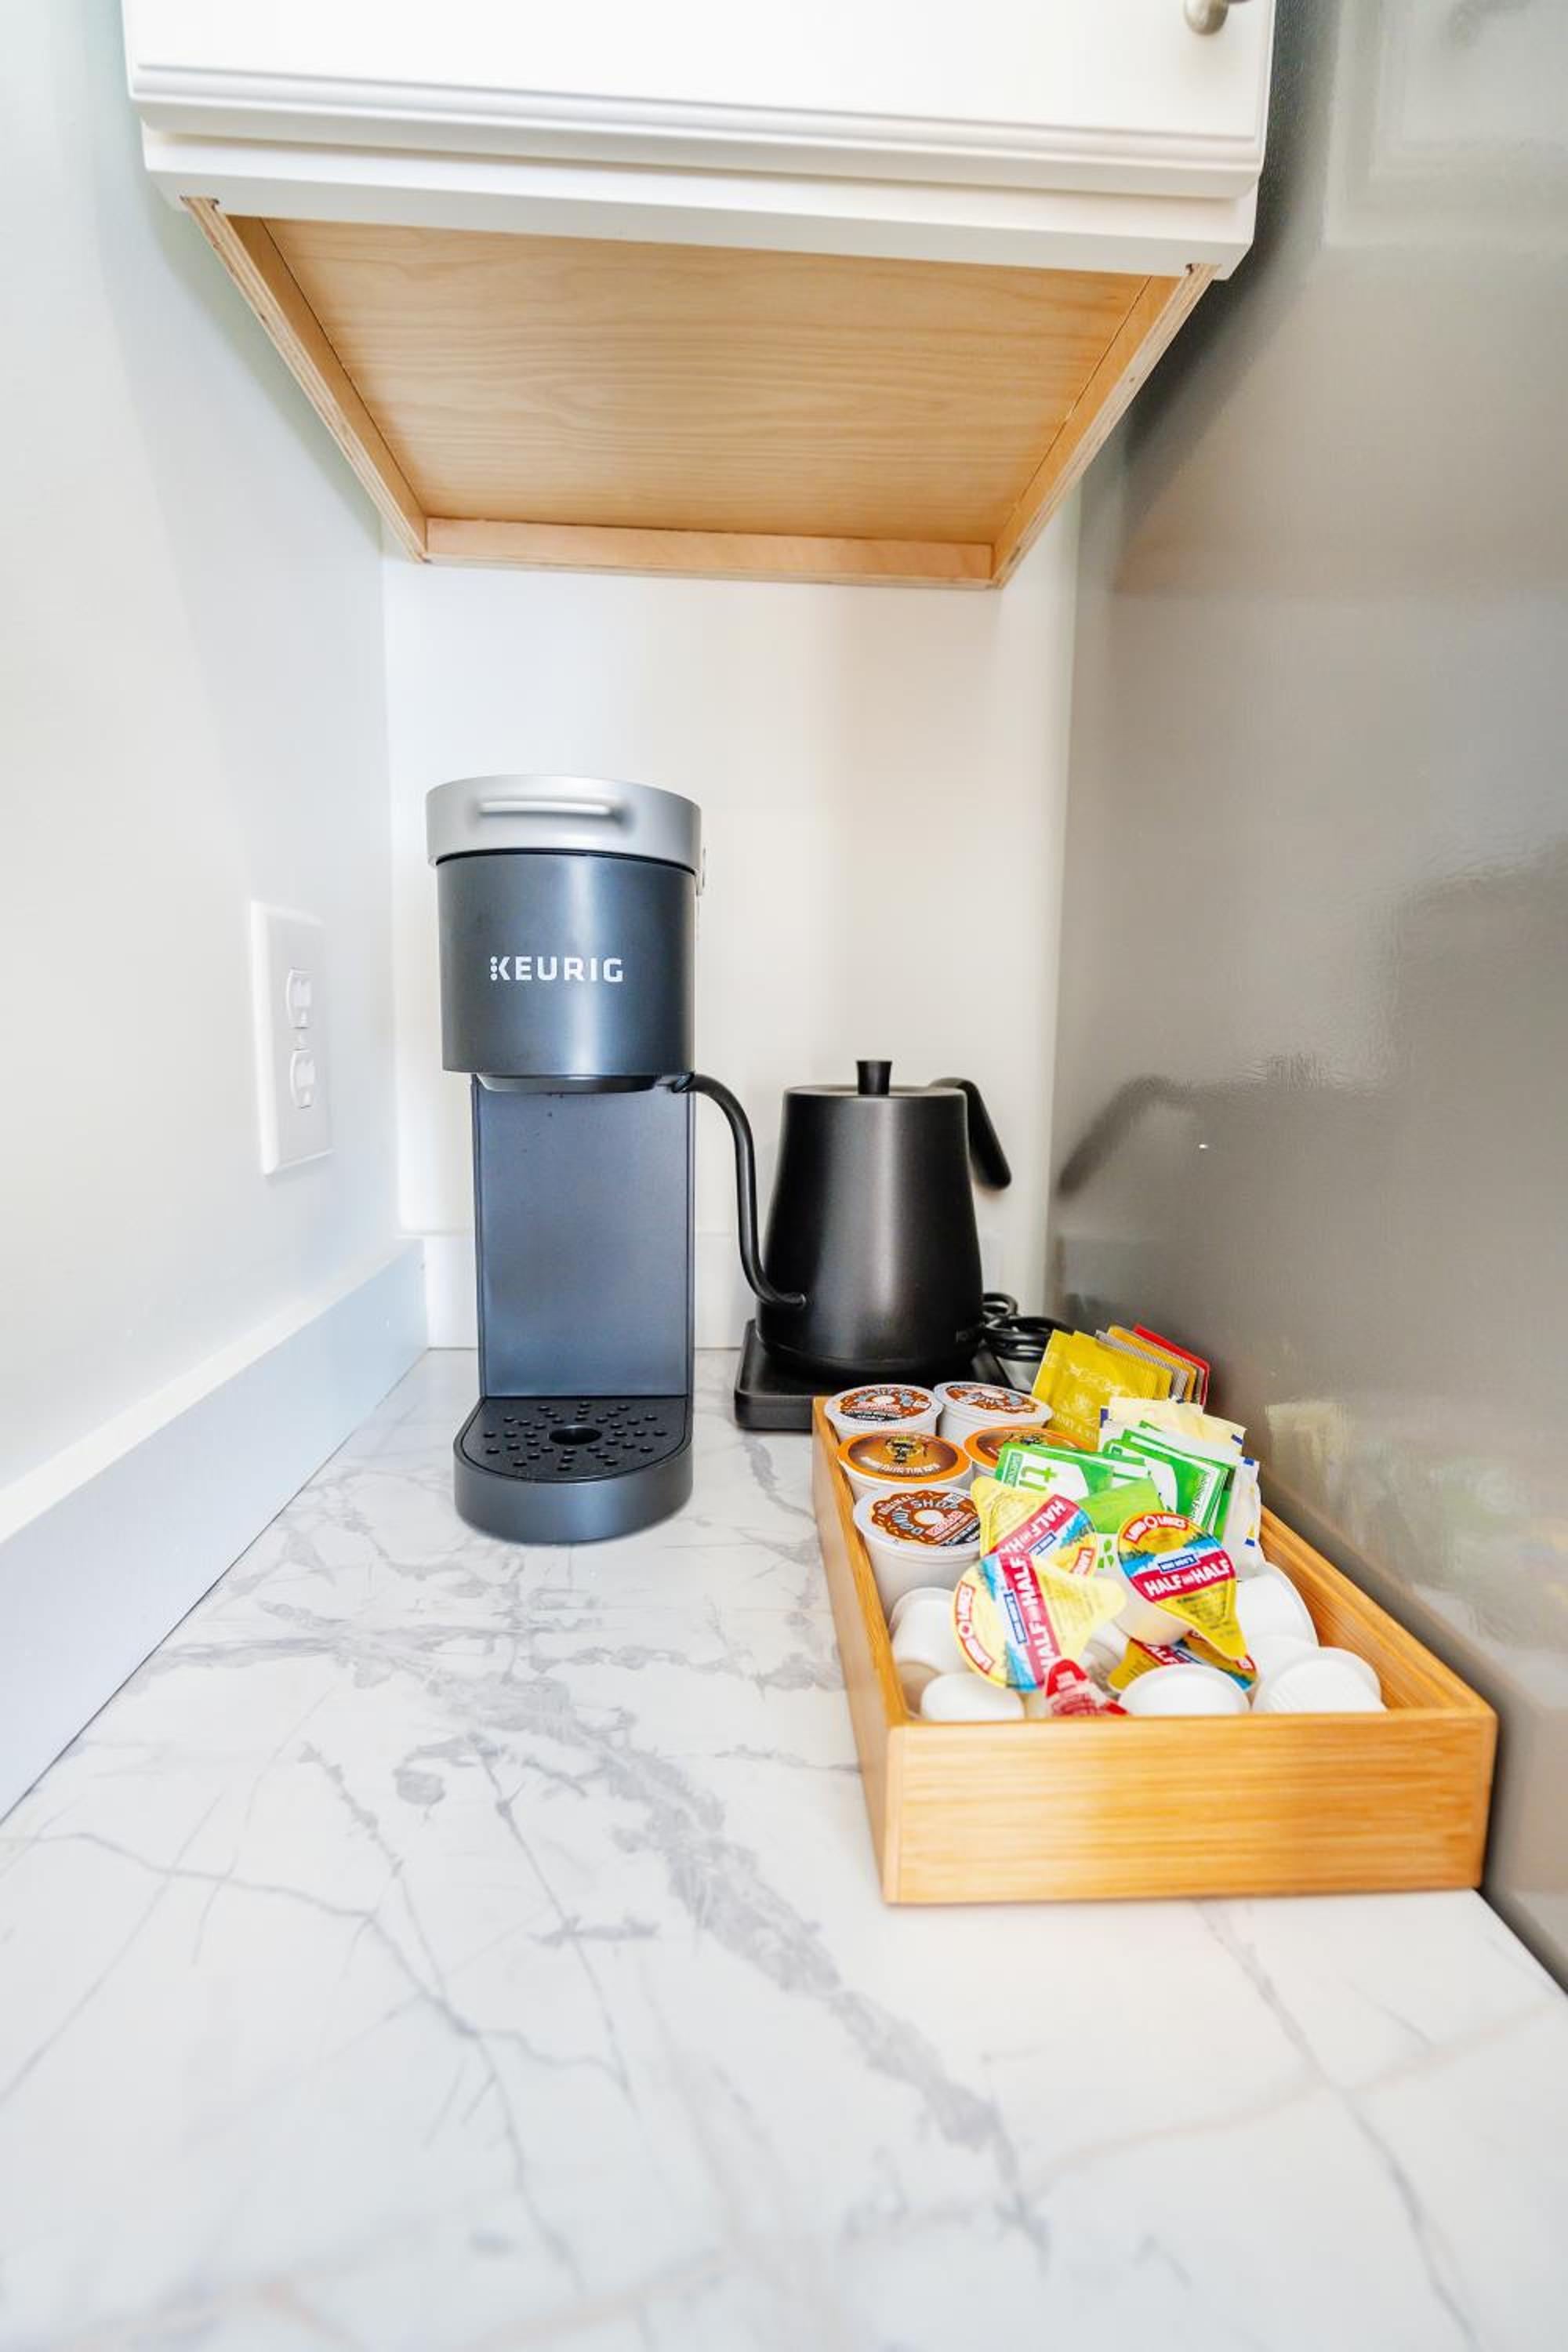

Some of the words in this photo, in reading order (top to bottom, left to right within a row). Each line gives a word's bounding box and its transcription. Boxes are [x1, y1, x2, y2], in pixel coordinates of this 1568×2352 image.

[490, 956, 623, 982] KEURIG
[1029, 1499, 1067, 1537] HALF
[1008, 1556, 1040, 1606] HALF
[1143, 1573, 1182, 1597] HALF
[1191, 1558, 1230, 1584] HALF
